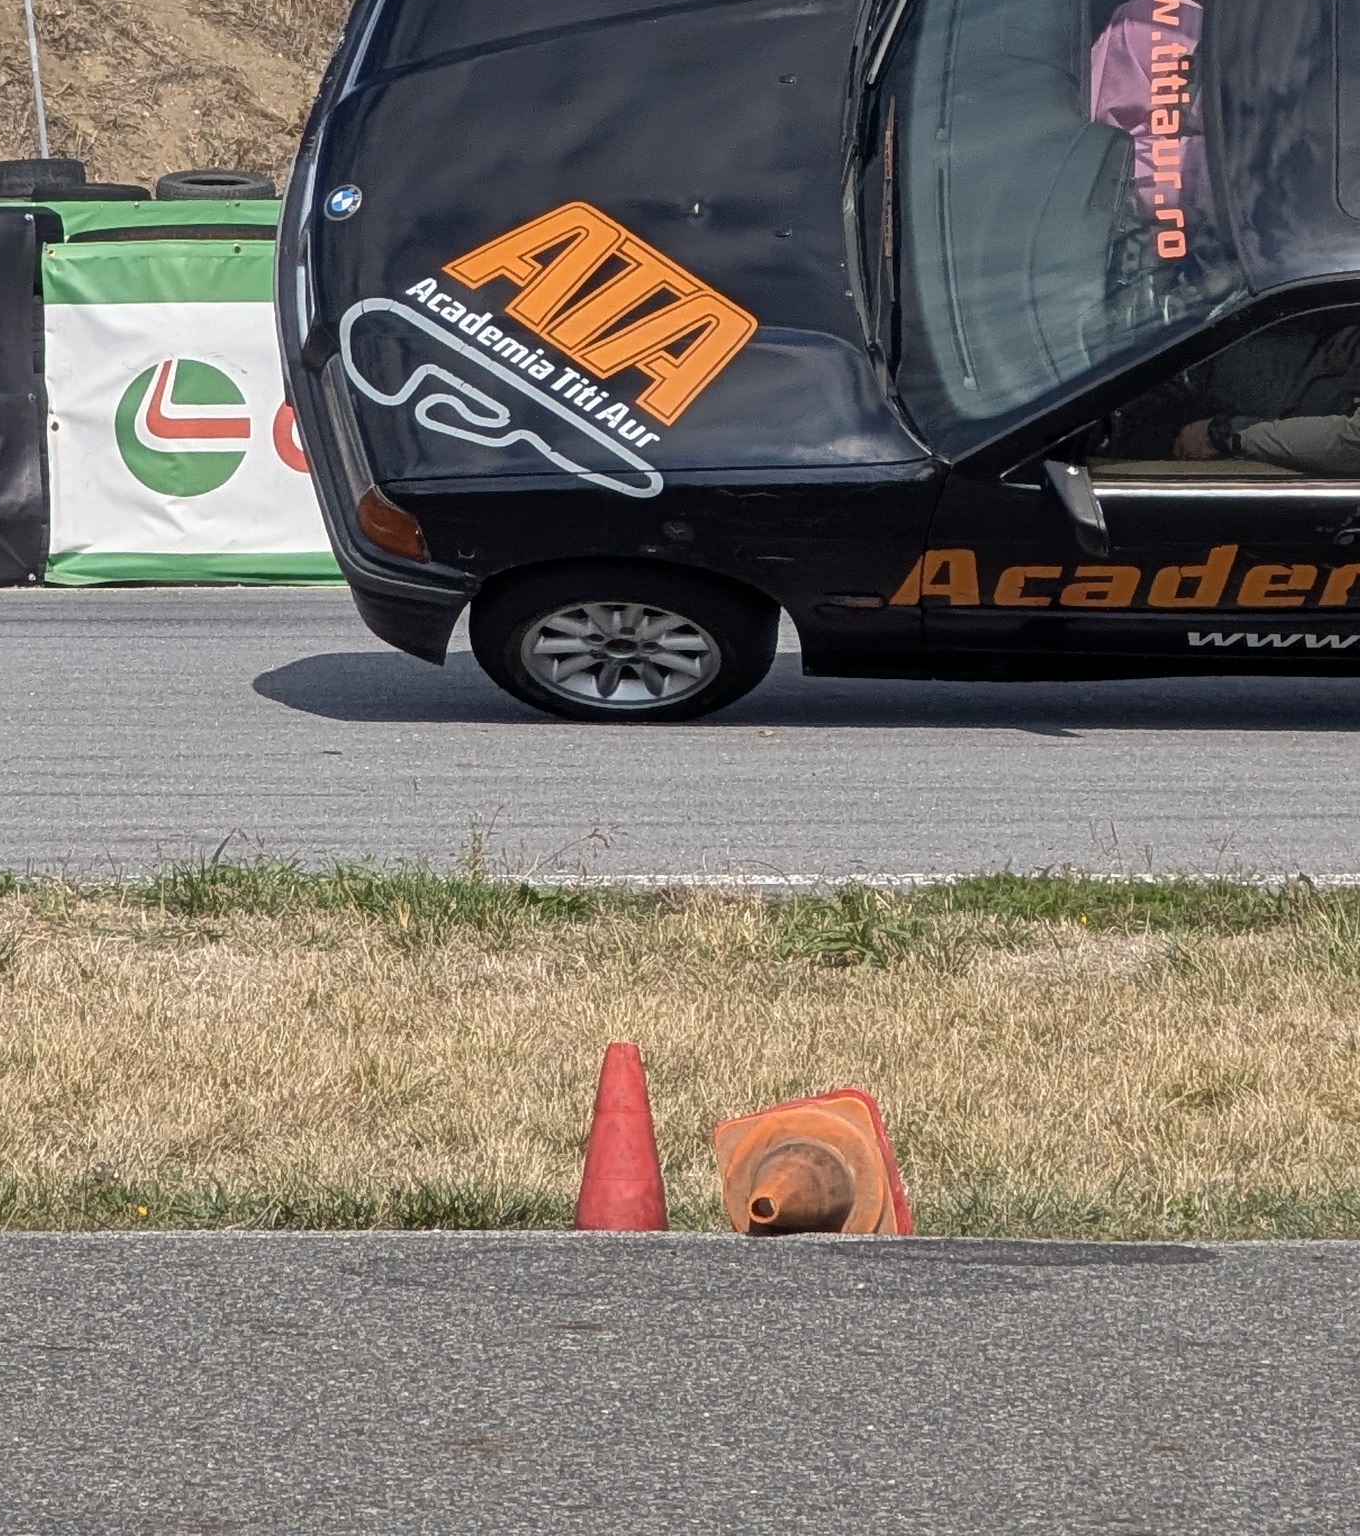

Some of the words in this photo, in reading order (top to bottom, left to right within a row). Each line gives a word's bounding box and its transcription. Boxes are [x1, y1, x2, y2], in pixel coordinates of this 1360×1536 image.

[405, 277, 556, 381] Academia
[551, 366, 611, 412] Titi
[595, 402, 661, 449] Aur
[442, 201, 760, 426] ATA
